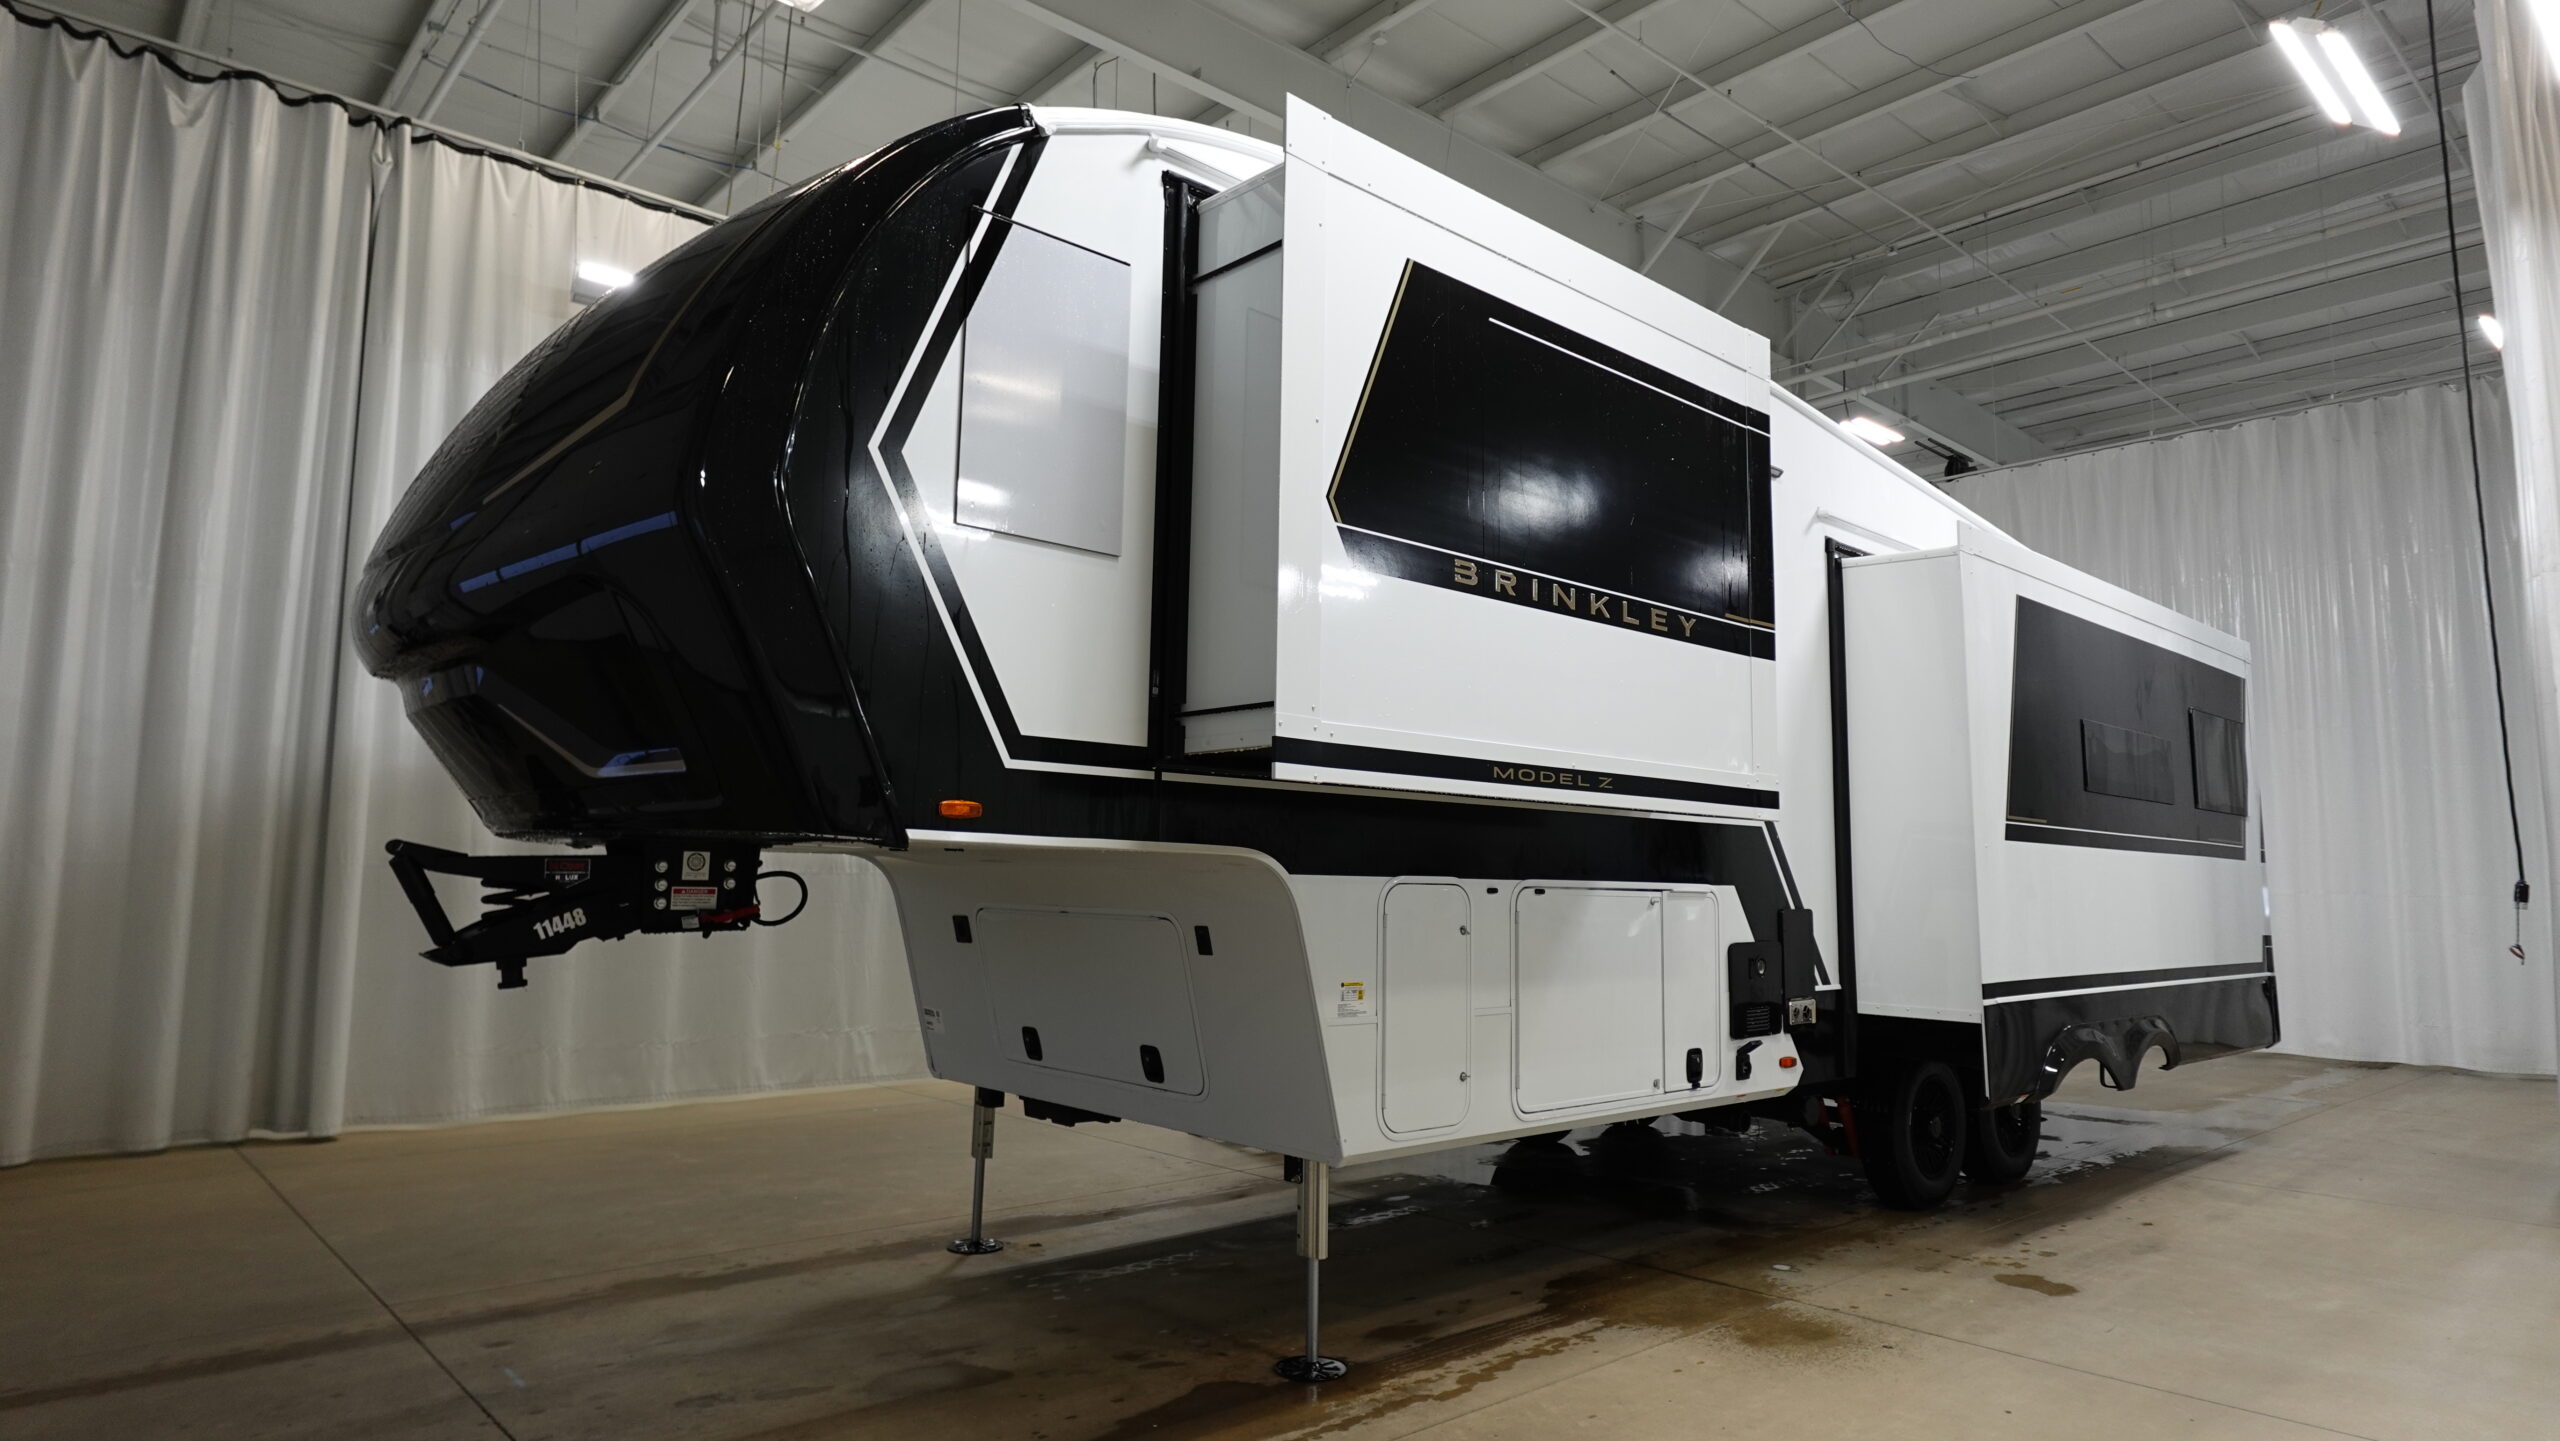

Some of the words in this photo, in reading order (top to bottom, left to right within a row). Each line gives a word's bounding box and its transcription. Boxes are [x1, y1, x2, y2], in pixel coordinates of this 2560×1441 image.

[1454, 558, 1697, 637] BRINKLEY
[1493, 766, 1590, 787] MODEL
[1598, 776, 1613, 789] Z
[533, 907, 587, 940] 11448
